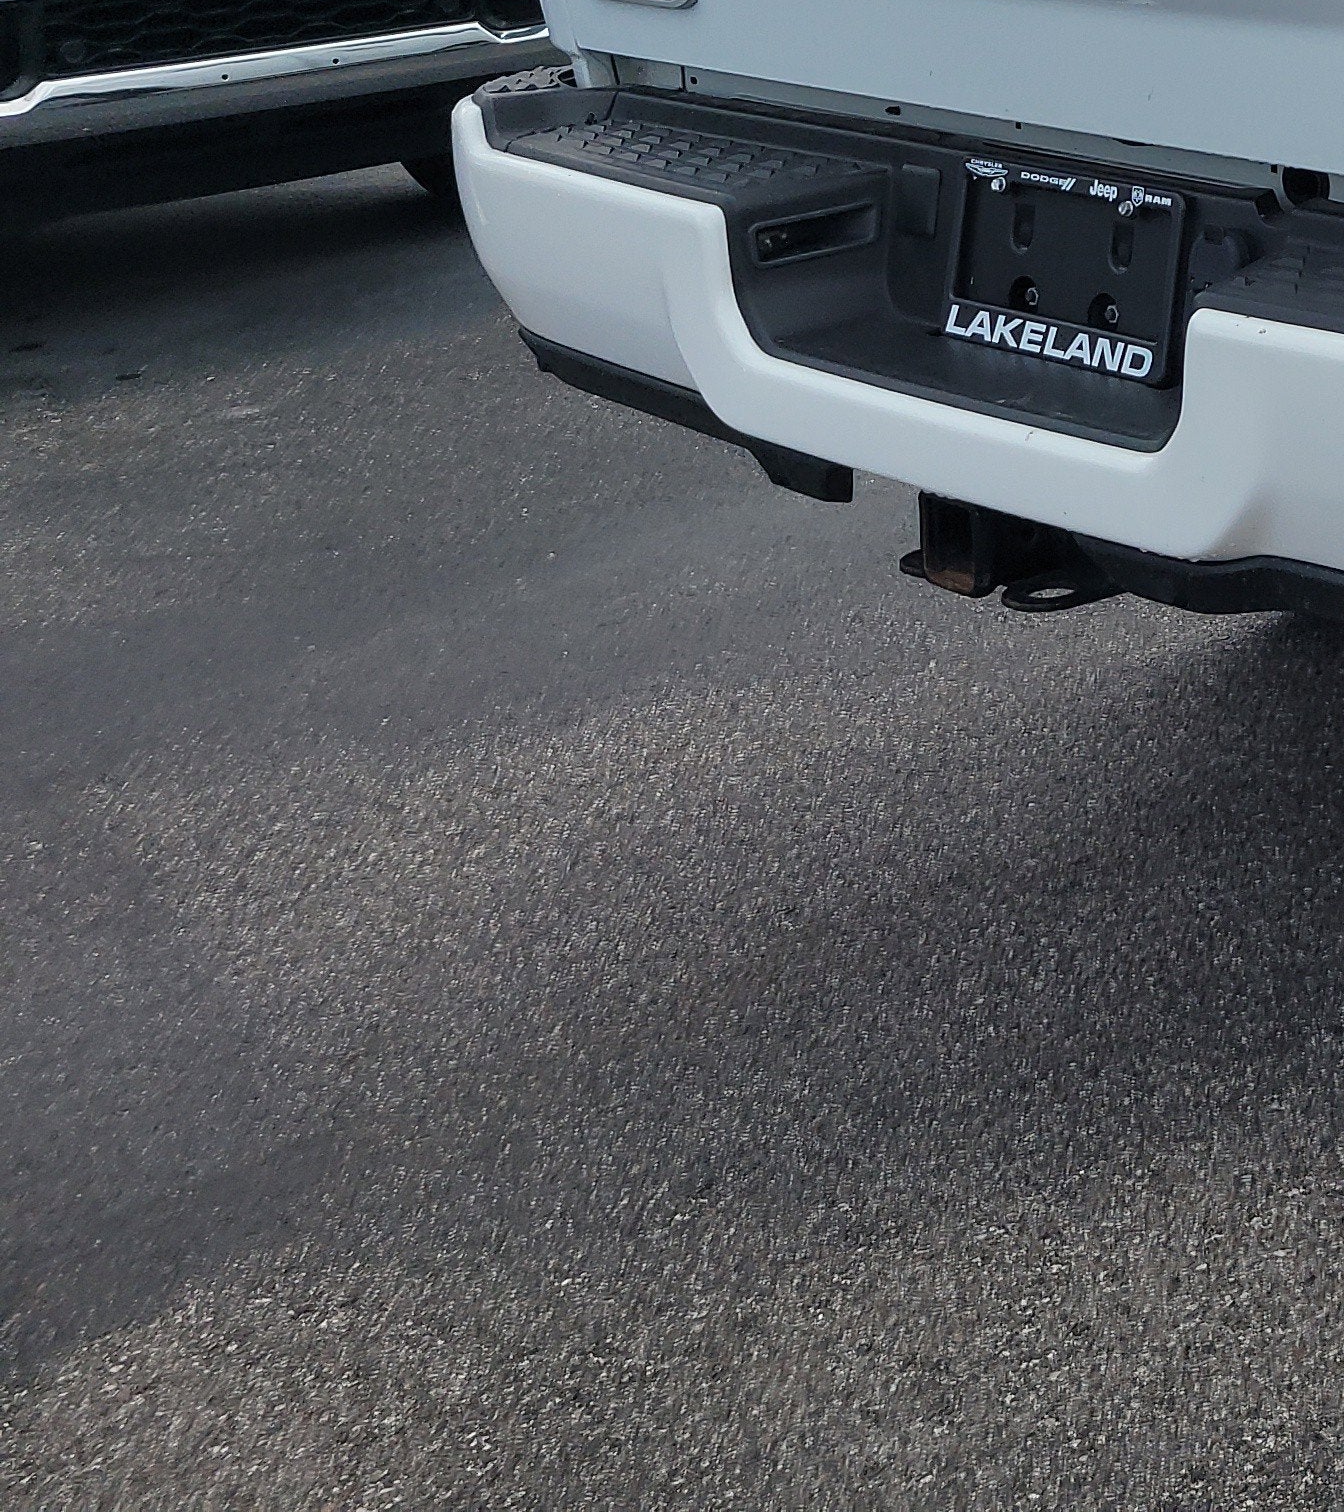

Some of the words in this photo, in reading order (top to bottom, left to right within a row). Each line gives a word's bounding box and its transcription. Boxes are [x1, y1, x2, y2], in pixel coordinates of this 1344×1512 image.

[970, 158, 1003, 169] CHRYSLER
[1020, 171, 1067, 187] DODGE
[1089, 179, 1118, 202] Jeep
[1144, 193, 1173, 207] RAM
[945, 304, 1154, 378] LAKELAND
